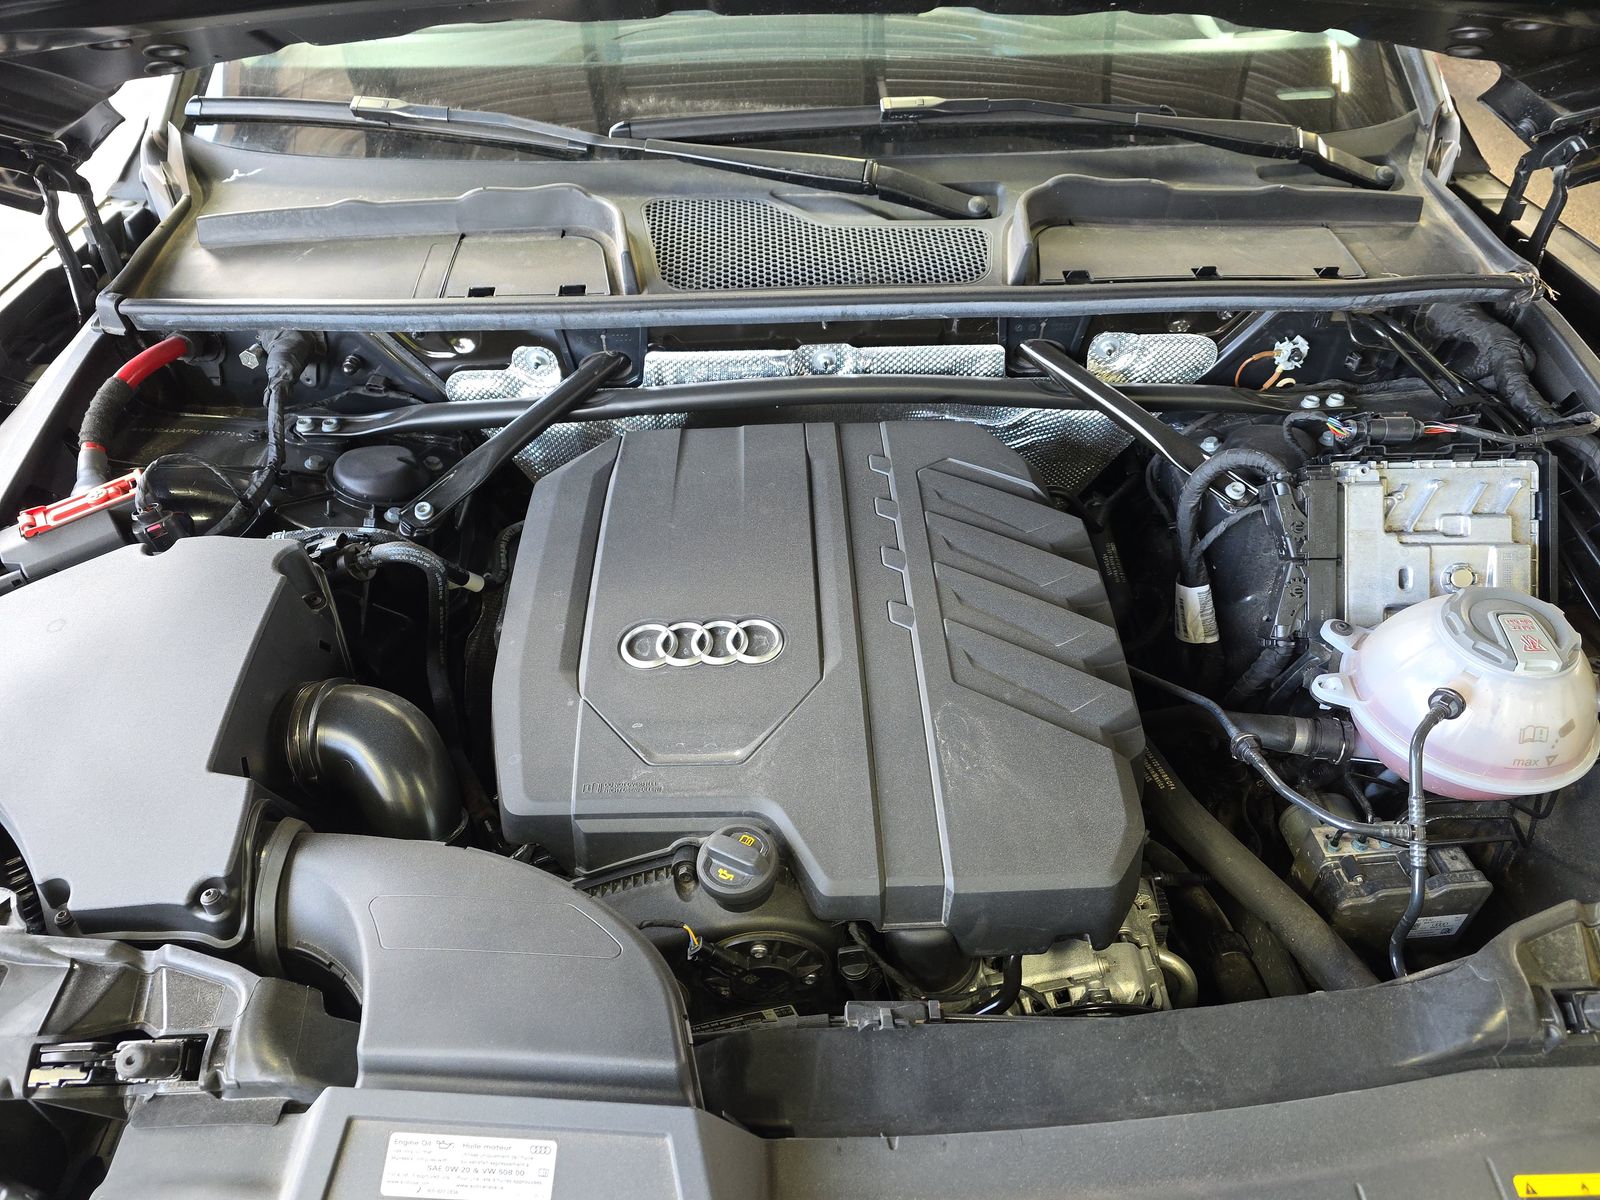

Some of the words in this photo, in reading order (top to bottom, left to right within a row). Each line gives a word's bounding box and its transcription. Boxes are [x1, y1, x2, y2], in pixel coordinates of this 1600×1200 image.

[1512, 758, 1540, 767] max
[393, 1138, 419, 1147] Engine
[421, 1139, 432, 1147] Oil
[482, 1143, 513, 1151] moteur
[427, 1164, 443, 1172] SAE
